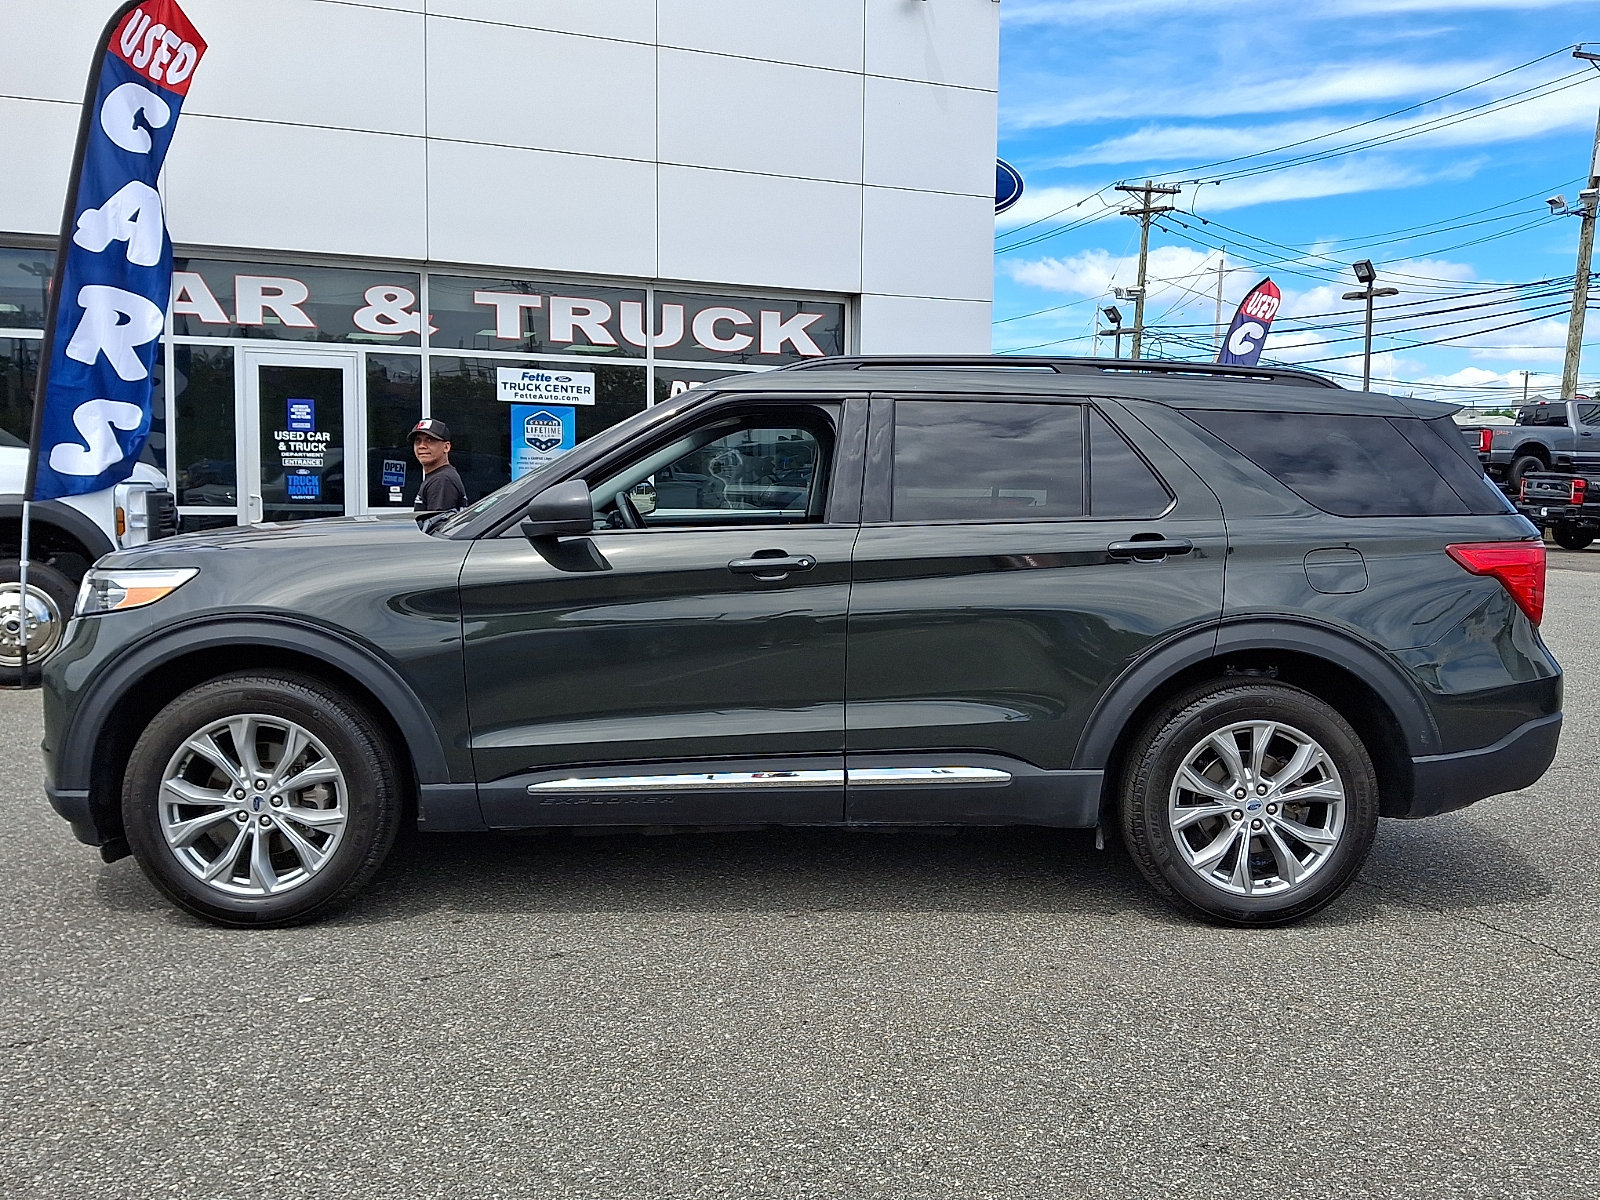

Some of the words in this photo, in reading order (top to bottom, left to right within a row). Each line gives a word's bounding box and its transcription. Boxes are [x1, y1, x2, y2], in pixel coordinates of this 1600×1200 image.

[120, 8, 198, 85] USED
[49, 82, 164, 476] CARS
[1246, 291, 1279, 320] USED
[172, 271, 318, 328] AR
[353, 285, 439, 336] &
[473, 290, 824, 357] TRUCK
[521, 371, 552, 382] Fette
[501, 382, 541, 392] TRUCK
[544, 384, 591, 395] CENTER
[514, 392, 579, 401] FetteAuto.com
[526, 426, 561, 434] LIFETIME
[274, 431, 305, 440] USED
[306, 431, 330, 441] CAR
[278, 441, 287, 451] &
[289, 441, 327, 451] TRUCK
[384, 462, 404, 472] OPEN
[287, 475, 319, 485] TRUCK
[288, 485, 319, 495] MONTH
[540, 796, 674, 805] EXPLORER
